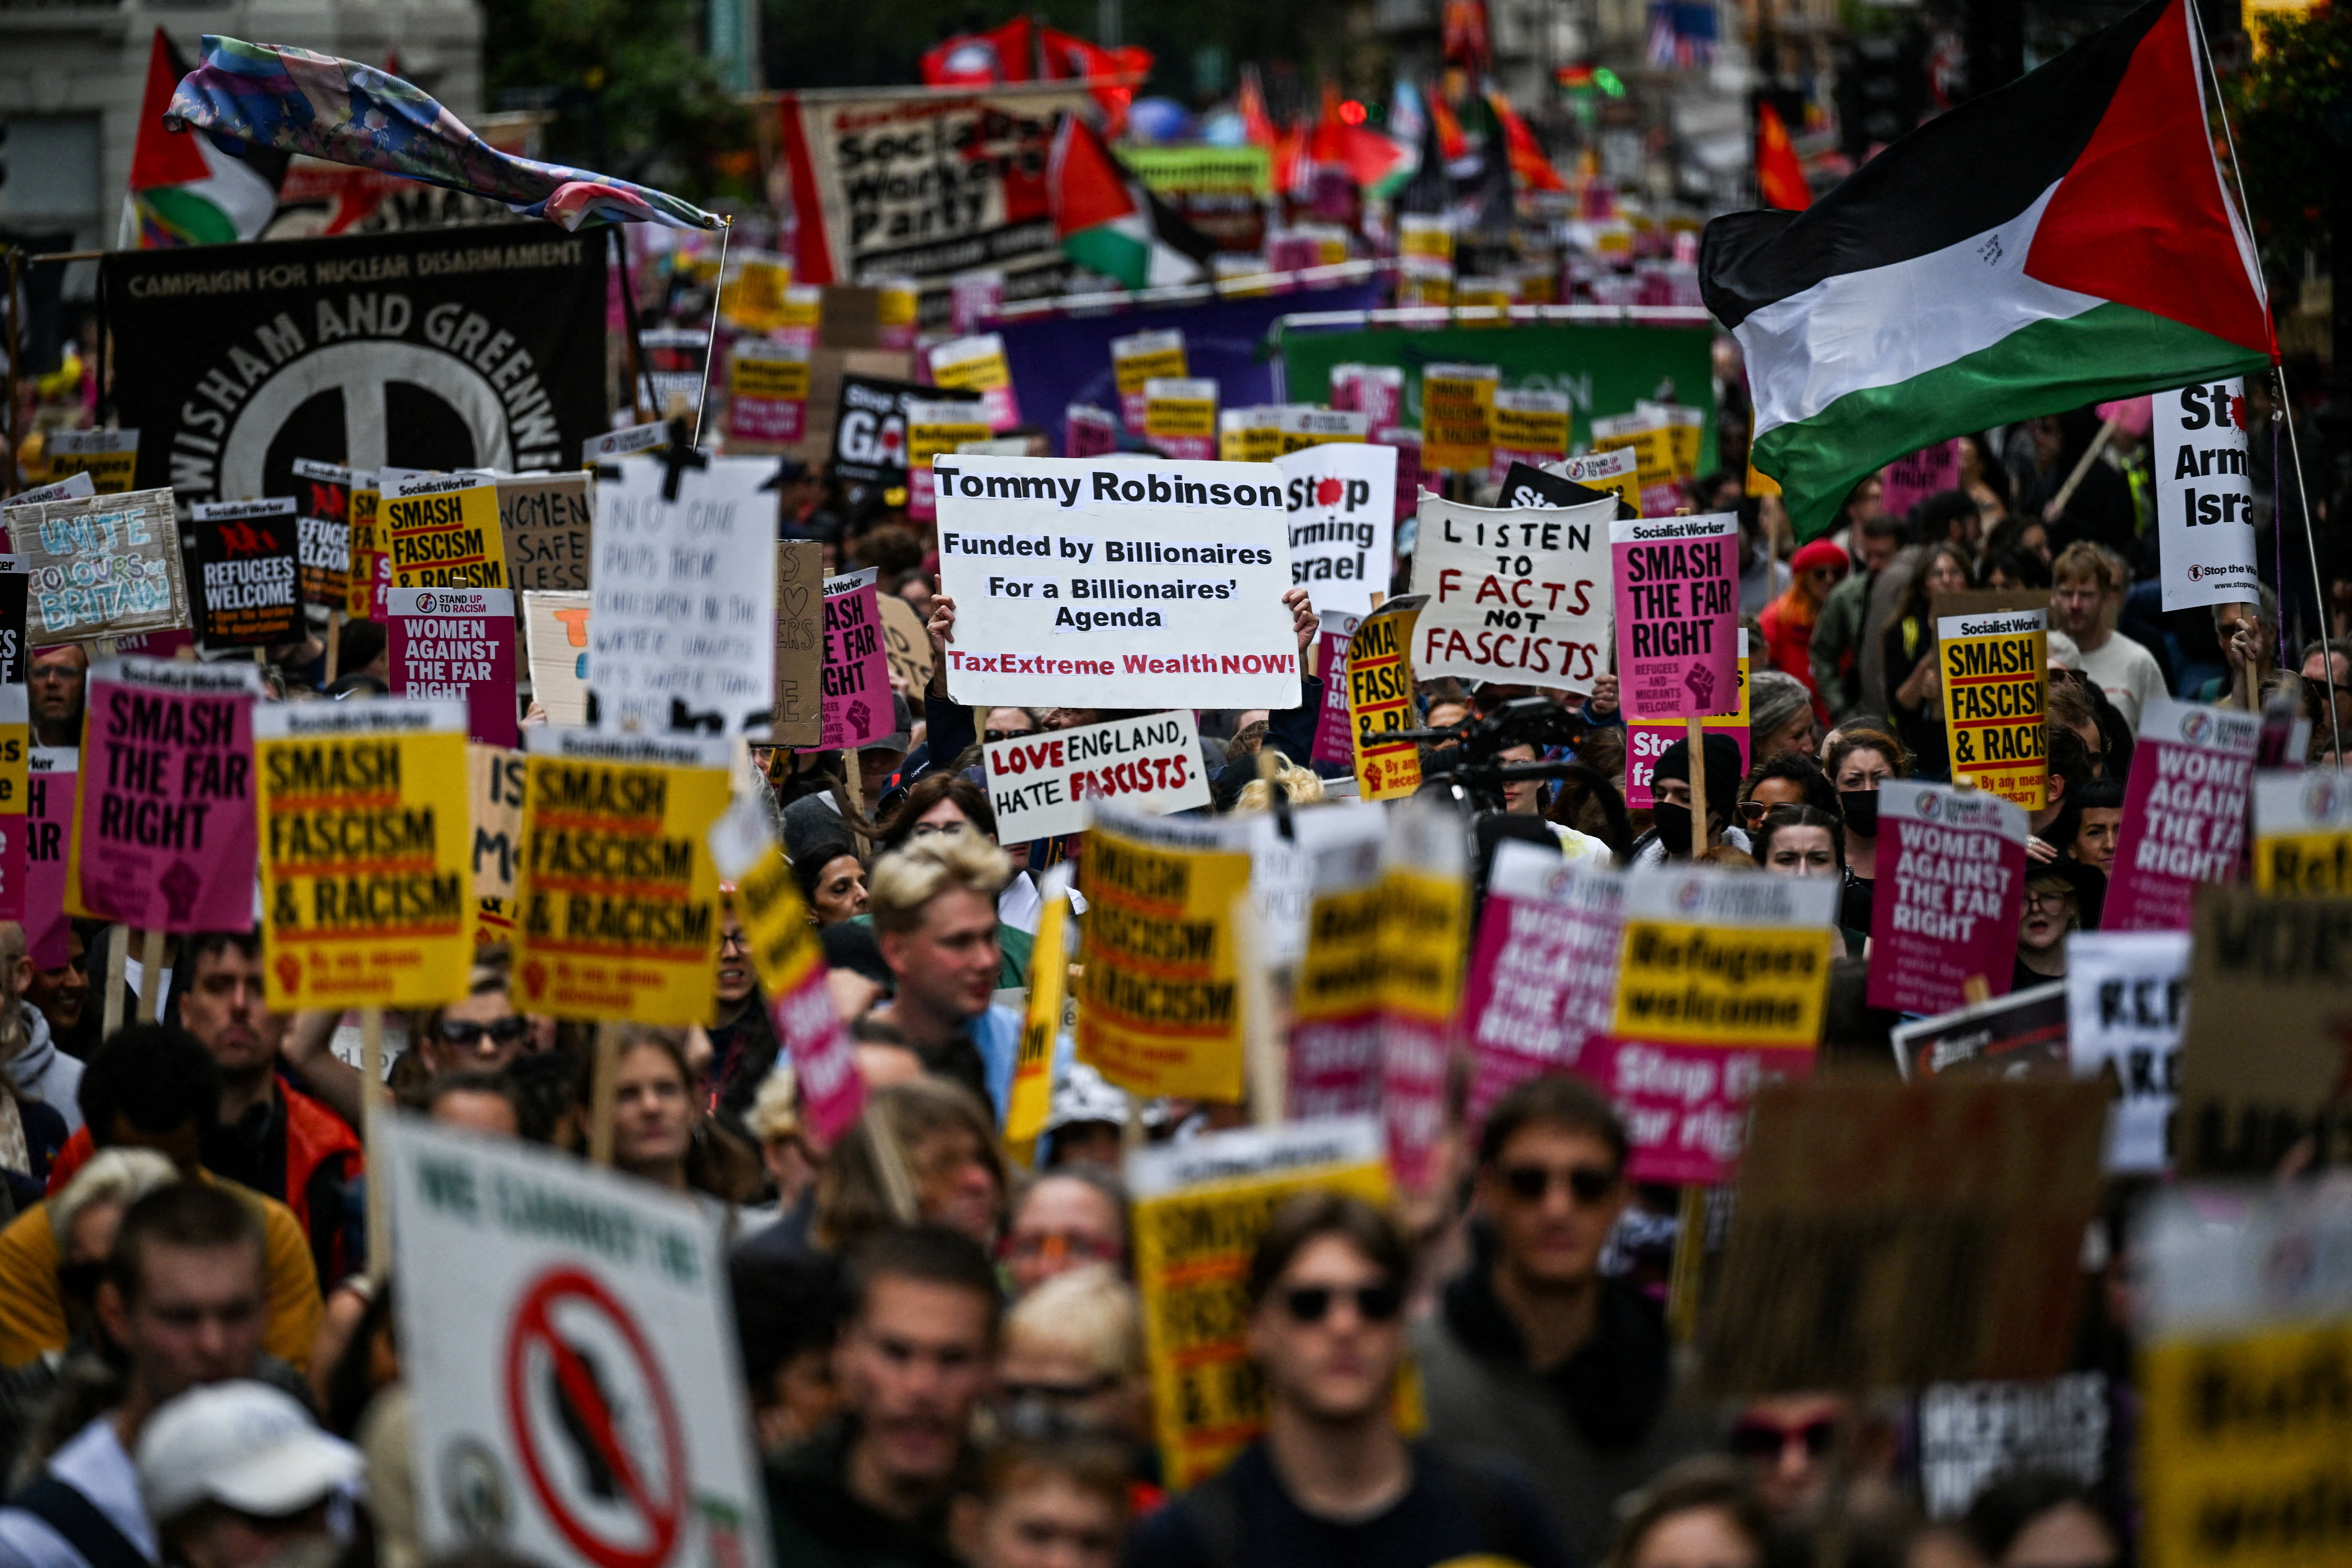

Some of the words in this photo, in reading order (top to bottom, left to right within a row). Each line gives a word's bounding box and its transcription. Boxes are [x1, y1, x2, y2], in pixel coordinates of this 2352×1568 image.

[128, 268, 249, 299] CAMPAIGN
[257, 263, 306, 289] FOR
[317, 255, 409, 283] NUCLEAR
[417, 241, 584, 277] DISARMAMENT
[169, 313, 305, 492] WISHAM
[315, 294, 411, 342] AND
[425, 303, 562, 470] GREENWI
[2180, 385, 2240, 431] St
[839, 408, 907, 468] GA
[1586, 459, 1607, 469] STAND
[1609, 457, 1619, 466] UP
[1598, 464, 1622, 475] RACISM
[2175, 444, 2248, 480] Arm
[28, 492, 52, 504] STAND
[53, 487, 65, 499] UP
[399, 482, 439, 496] Socialist
[440, 478, 477, 491] Worker
[933, 466, 1081, 507] Tommy
[1092, 470, 1282, 507] Robinson
[1510, 485, 1558, 508] St
[389, 496, 462, 530] SMASH
[2185, 488, 2254, 527] Isra
[40, 508, 150, 555] UNITE
[298, 519, 350, 546] EFUGE
[393, 528, 484, 565] FASCISM
[517, 532, 585, 563] SAFE
[1443, 519, 1591, 553] LISTEN
[1633, 525, 1684, 539] Socialist
[1685, 522, 1724, 535] Worker
[944, 533, 1050, 556] Funded
[1060, 537, 1093, 563] by
[1106, 541, 1272, 565] Billionaires
[1496, 555, 1533, 576] TO
[1627, 543, 1722, 582] SMASH
[29, 553, 144, 595] COLOURS
[204, 555, 295, 587] REFUGEES
[508, 565, 587, 590] LESS
[834, 578, 862, 593] Worker
[1292, 551, 1365, 584] srael
[2204, 566, 2226, 576] Stop
[2228, 565, 2244, 574] the
[2246, 565, 2257, 575] Wa
[38, 579, 170, 633] BRITAIN
[206, 581, 295, 610] WELCOME
[439, 594, 466, 603] STAND
[470, 594, 482, 603] UP
[989, 576, 1034, 598] For
[1042, 583, 1059, 598] a
[1072, 578, 1237, 600] Billionaires'
[1439, 569, 1595, 616] FACTS
[1628, 583, 1681, 620] THE
[1690, 579, 1732, 617] FAR
[440, 604, 451, 613] TO
[453, 604, 486, 613] RACISM
[824, 594, 864, 632] ASH
[1055, 607, 1162, 631] Agenda
[1484, 610, 1546, 633] NOT
[404, 619, 486, 639] WOMEN
[844, 624, 877, 662] FAR
[1351, 619, 1399, 660] SMA
[1632, 619, 1714, 658] RIGHT
[1961, 620, 2011, 635] Socialist
[404, 641, 499, 659] AGAINST
[1123, 653, 1217, 674] Wealth
[1425, 628, 1599, 681] FASCISTS
[1947, 639, 2033, 677] SMASH
[405, 661, 448, 680] THE
[452, 661, 492, 680] FAR
[824, 662, 864, 696] GHT
[1329, 674, 1347, 690] TH
[1352, 662, 1406, 705] FASC
[1636, 663, 1678, 675] REFUGEES
[1648, 677, 1667, 687] AND
[406, 682, 470, 700] RIGHT
[1636, 689, 1681, 700] MIGRANTS
[1637, 700, 1681, 713] WELCOME
[108, 690, 234, 748] SMASH
[824, 724, 844, 733] ANTS
[991, 740, 1064, 776] LOVE
[1068, 720, 1187, 762] ENGLAND,
[1633, 731, 1676, 756] Sto
[1956, 731, 1975, 763] &
[1983, 726, 2045, 761] RACIS
[26, 757, 53, 771] ker
[106, 741, 171, 796] THE
[182, 751, 249, 803] FAR
[267, 741, 402, 793] SMASH
[1385, 759, 1396, 773] By
[1633, 762, 1654, 786] fa
[2155, 745, 2250, 789] WOME
[537, 766, 668, 814] SMASH
[996, 779, 1063, 816] HATE
[1070, 754, 1196, 802] FASCISTS.
[1981, 776, 1994, 790] By
[1998, 776, 2015, 788] any
[2020, 775, 2046, 786] mean
[1998, 790, 2035, 804] essary
[2148, 779, 2246, 818] AGAIN
[101, 793, 210, 849] RIGHT
[269, 805, 437, 861] FASCISM
[2145, 807, 2203, 846] THE
[2210, 820, 2242, 851] FA
[530, 828, 693, 880] FASCISM
[1898, 823, 2001, 861] WOMEN
[1898, 851, 2012, 895] AGAINST
[2135, 840, 2232, 885] RIGHT
[313, 868, 463, 926] RACISM
[1895, 877, 1948, 911] THE
[1952, 889, 2003, 921] FAR
[566, 897, 712, 947] RACISM
[1893, 904, 1976, 942] RIGHT
[1632, 927, 1817, 981] Refugees
[1625, 991, 1802, 1027] welcome
